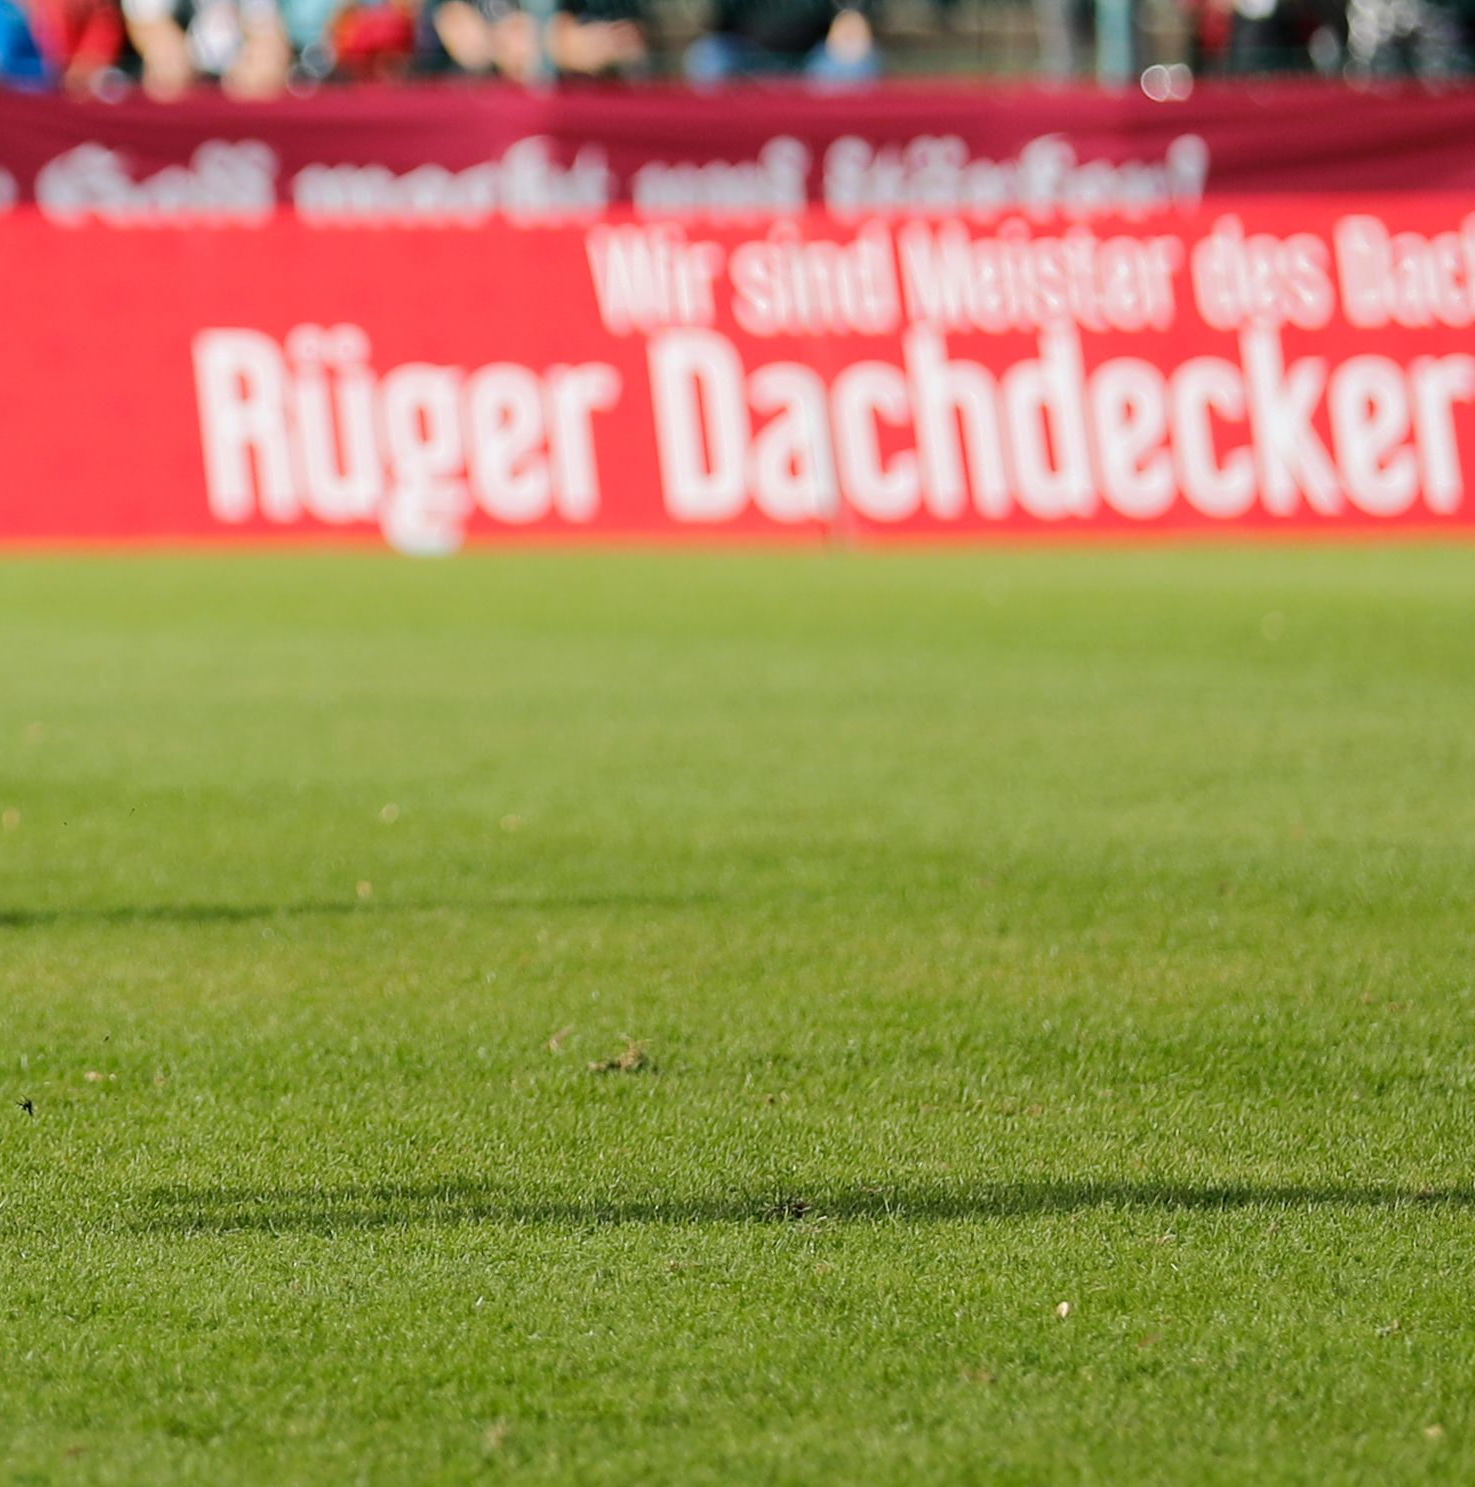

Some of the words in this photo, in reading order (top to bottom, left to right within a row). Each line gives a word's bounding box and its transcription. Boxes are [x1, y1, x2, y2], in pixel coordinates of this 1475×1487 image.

[588, 223, 724, 334] Wir
[729, 219, 900, 334] sind
[901, 218, 1183, 332] Meister
[1192, 215, 1335, 330] des
[1335, 213, 1475, 328] Dac
[193, 323, 622, 556] Rüger
[648, 316, 1475, 522] Dachdecker
